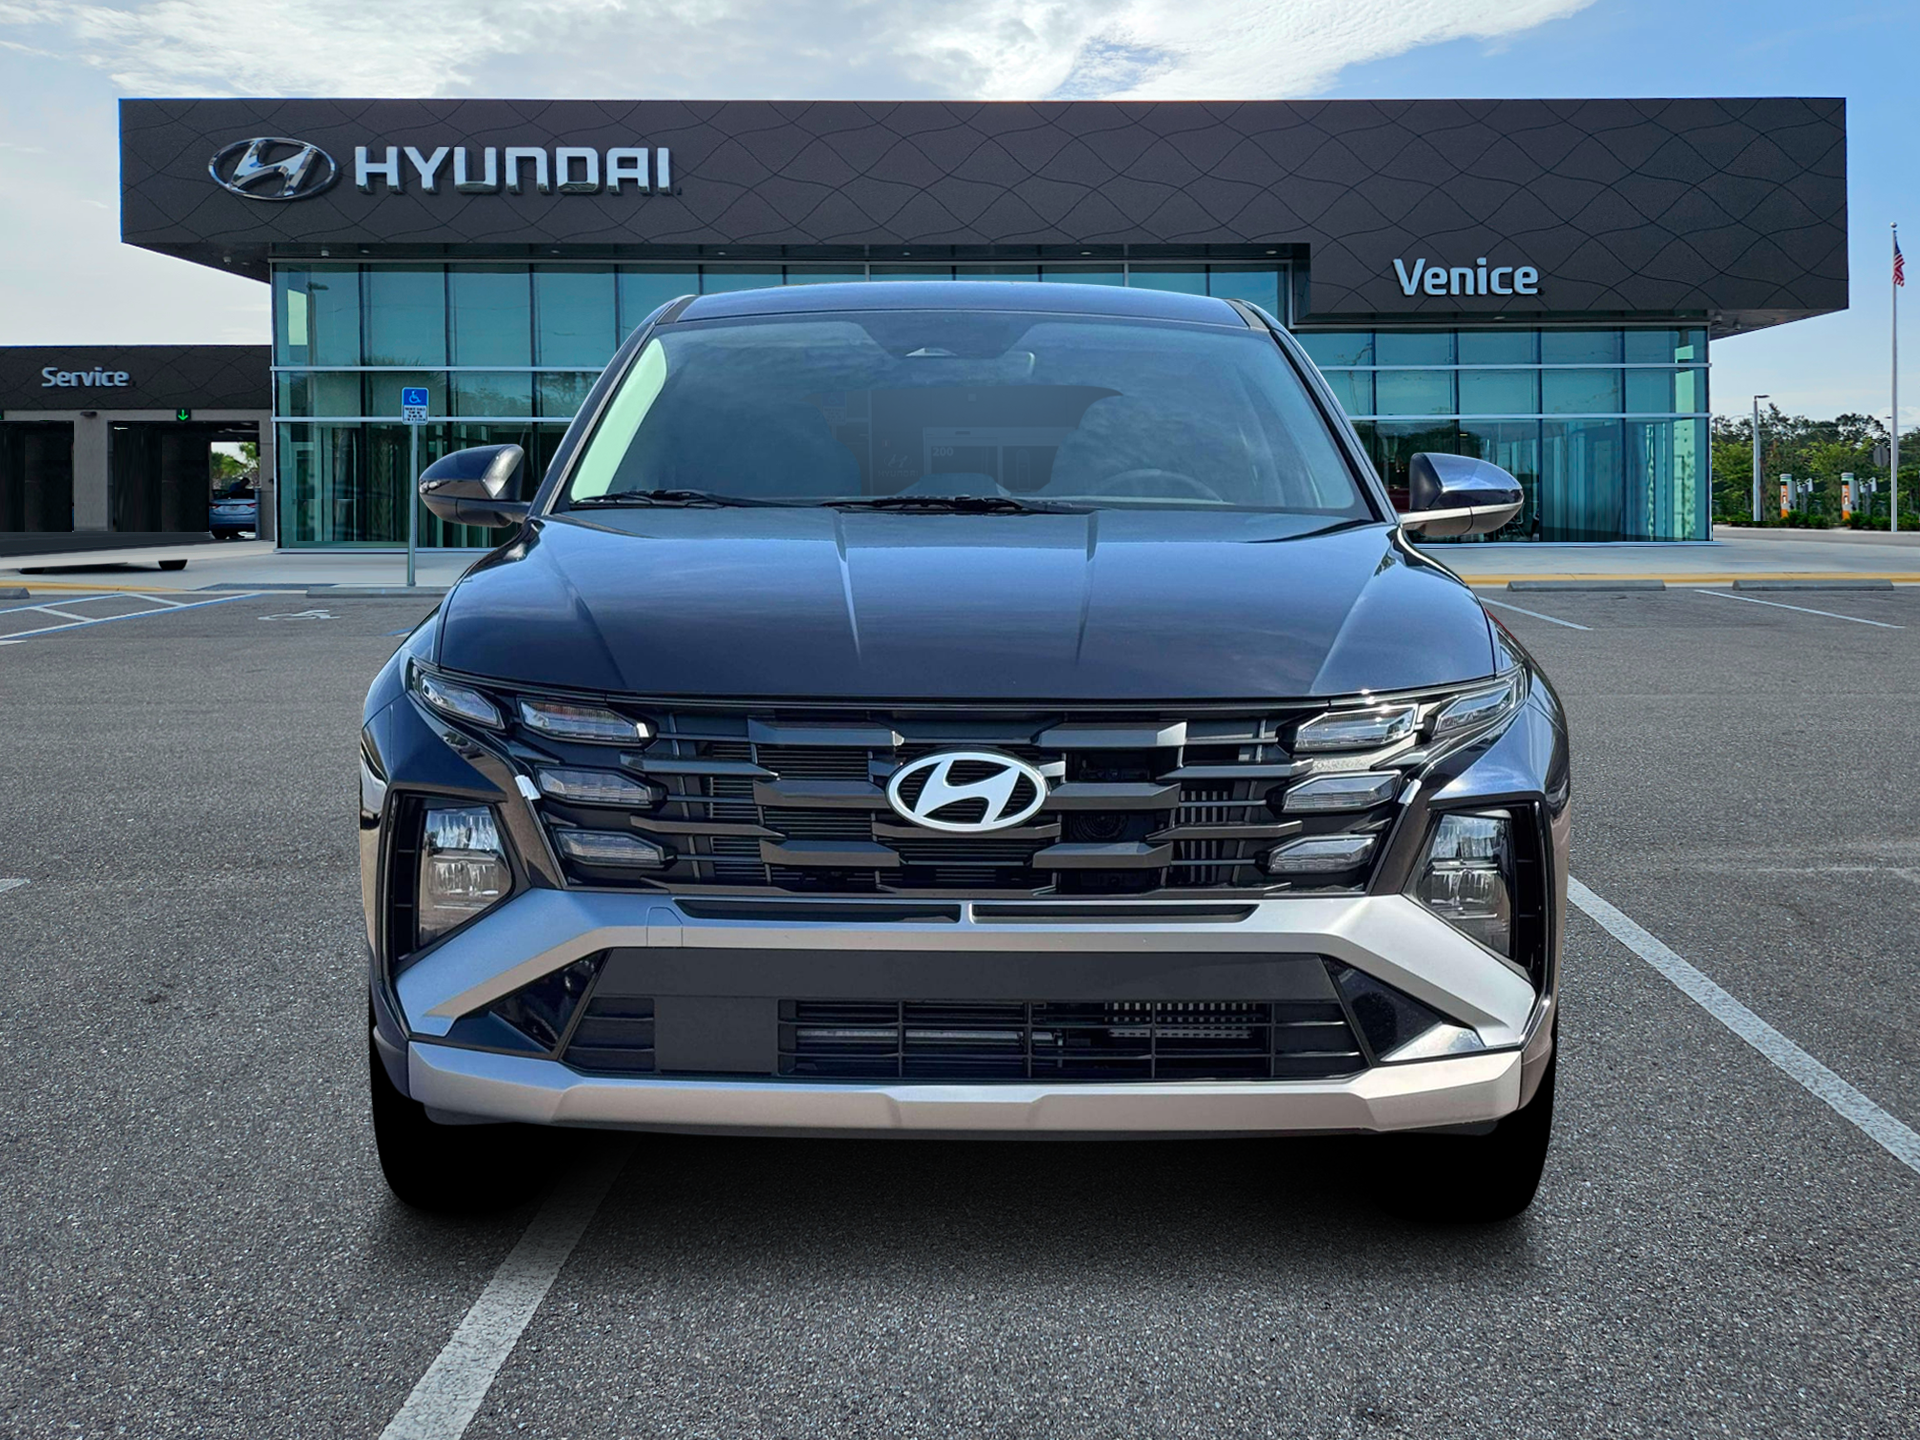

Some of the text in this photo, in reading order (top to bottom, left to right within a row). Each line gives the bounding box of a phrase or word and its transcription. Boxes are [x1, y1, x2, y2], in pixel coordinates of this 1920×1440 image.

[355, 146, 672, 194] HYUNDAI
[1393, 257, 1539, 296] Venice
[41, 366, 130, 387] Service
[932, 446, 954, 457] 200
